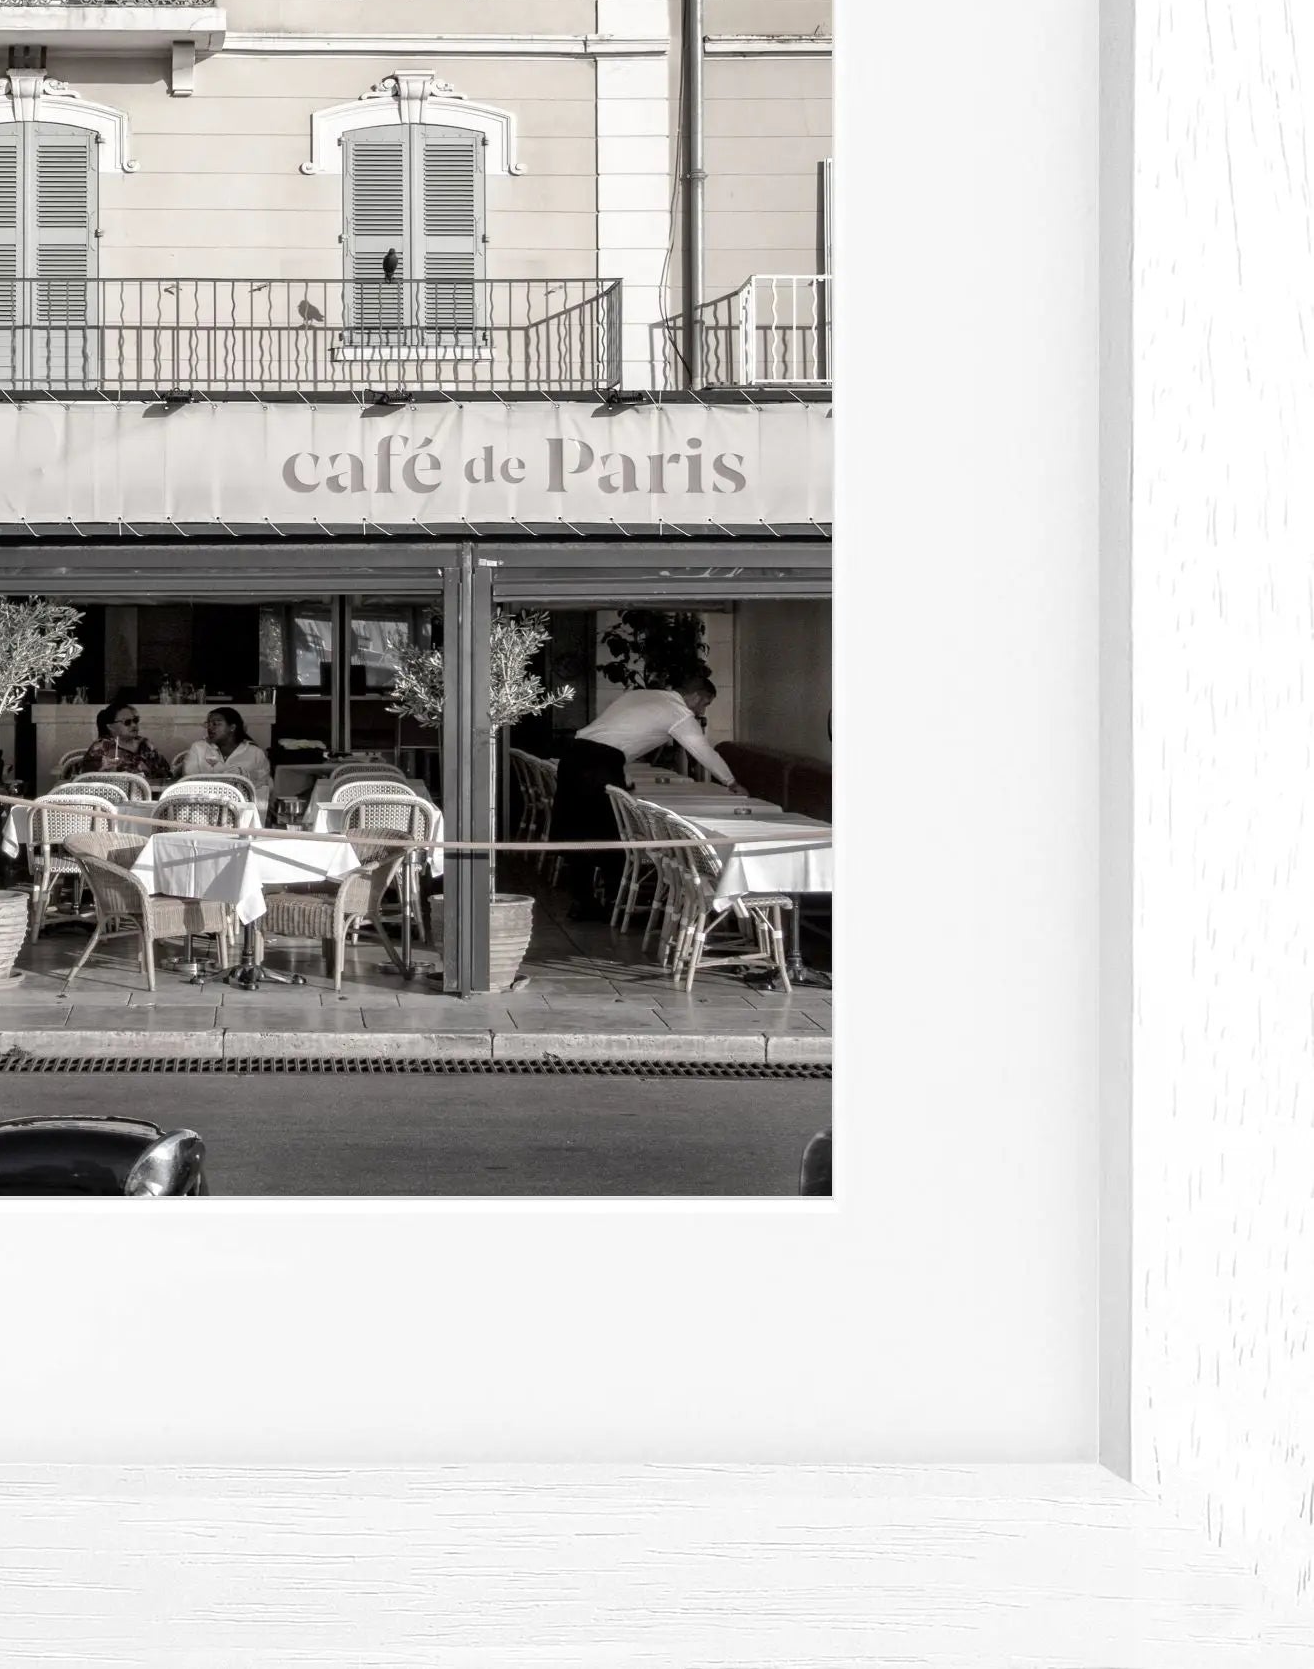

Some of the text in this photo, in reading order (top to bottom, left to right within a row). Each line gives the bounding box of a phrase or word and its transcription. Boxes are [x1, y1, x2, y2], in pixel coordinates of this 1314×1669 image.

[281, 434, 748, 495] café de Paris
